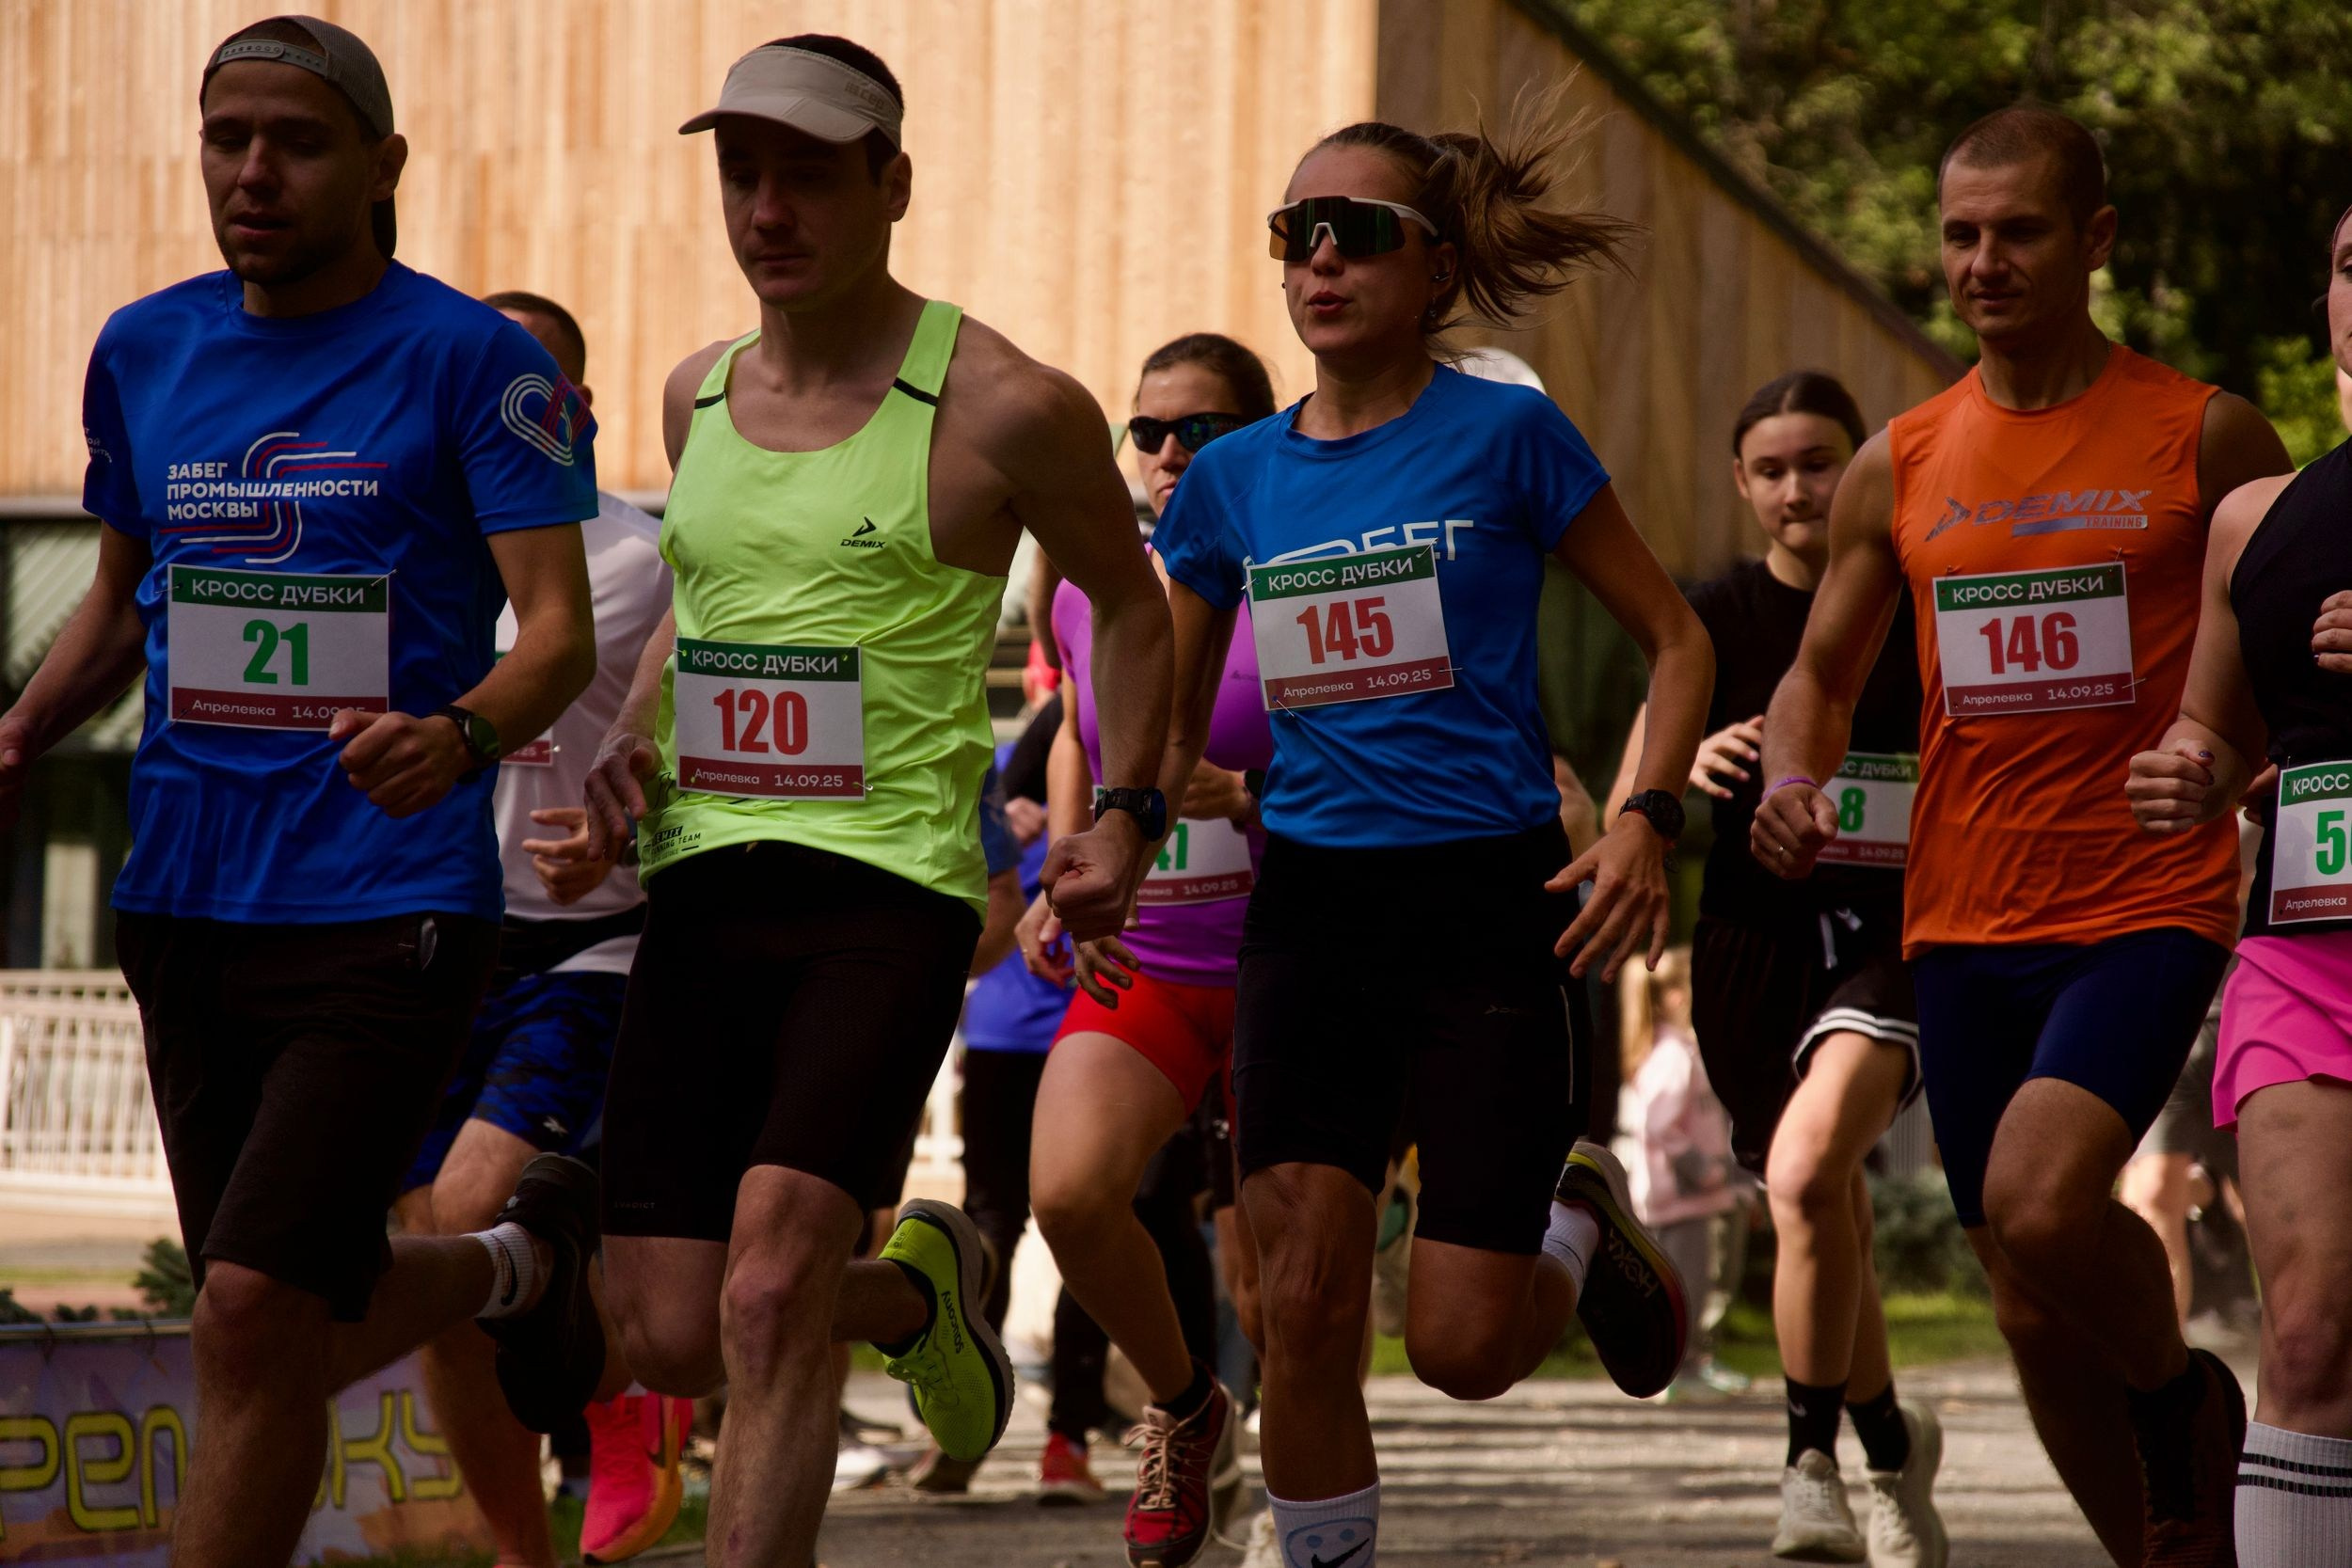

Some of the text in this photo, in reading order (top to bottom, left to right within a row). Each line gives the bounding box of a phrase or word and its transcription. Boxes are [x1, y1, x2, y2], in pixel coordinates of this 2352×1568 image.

[167, 462, 228, 479] ЗАБЕГ
[167, 480, 378, 499] ПРОМЫШЛЕННОСТИ
[167, 501, 258, 520] МОСКВЫ
[1972, 489, 2152, 527] DEMIX
[2085, 515, 2142, 529] TRAINING
[840, 539, 885, 547] DEMIX
[1268, 558, 1414, 592] КРОСС ДУБКИ
[192, 579, 364, 606] КРОСС ДУБКИ
[1953, 576, 2105, 604] КРОСС ДУБКИ
[1295, 596, 1394, 665] 145
[1979, 611, 2080, 675] 146
[243, 619, 309, 686] 21
[691, 648, 837, 674] КРОСС ДУБКИ
[1283, 669, 1432, 700] Апрелевка 14.09.25
[1963, 683, 2115, 706] Апрелевка 14.09.25
[192, 699, 276, 716] Апрелевка
[713, 689, 808, 755] 120
[695, 768, 844, 787] Апрелевка 14.09.25
[2292, 773, 2350, 797] КРОСС
[678, 832, 701, 845] TEAM
[2316, 810, 2352, 876] 5
[2285, 896, 2347, 911] Апрелевка
[942, 1291, 963, 1354] saucony
